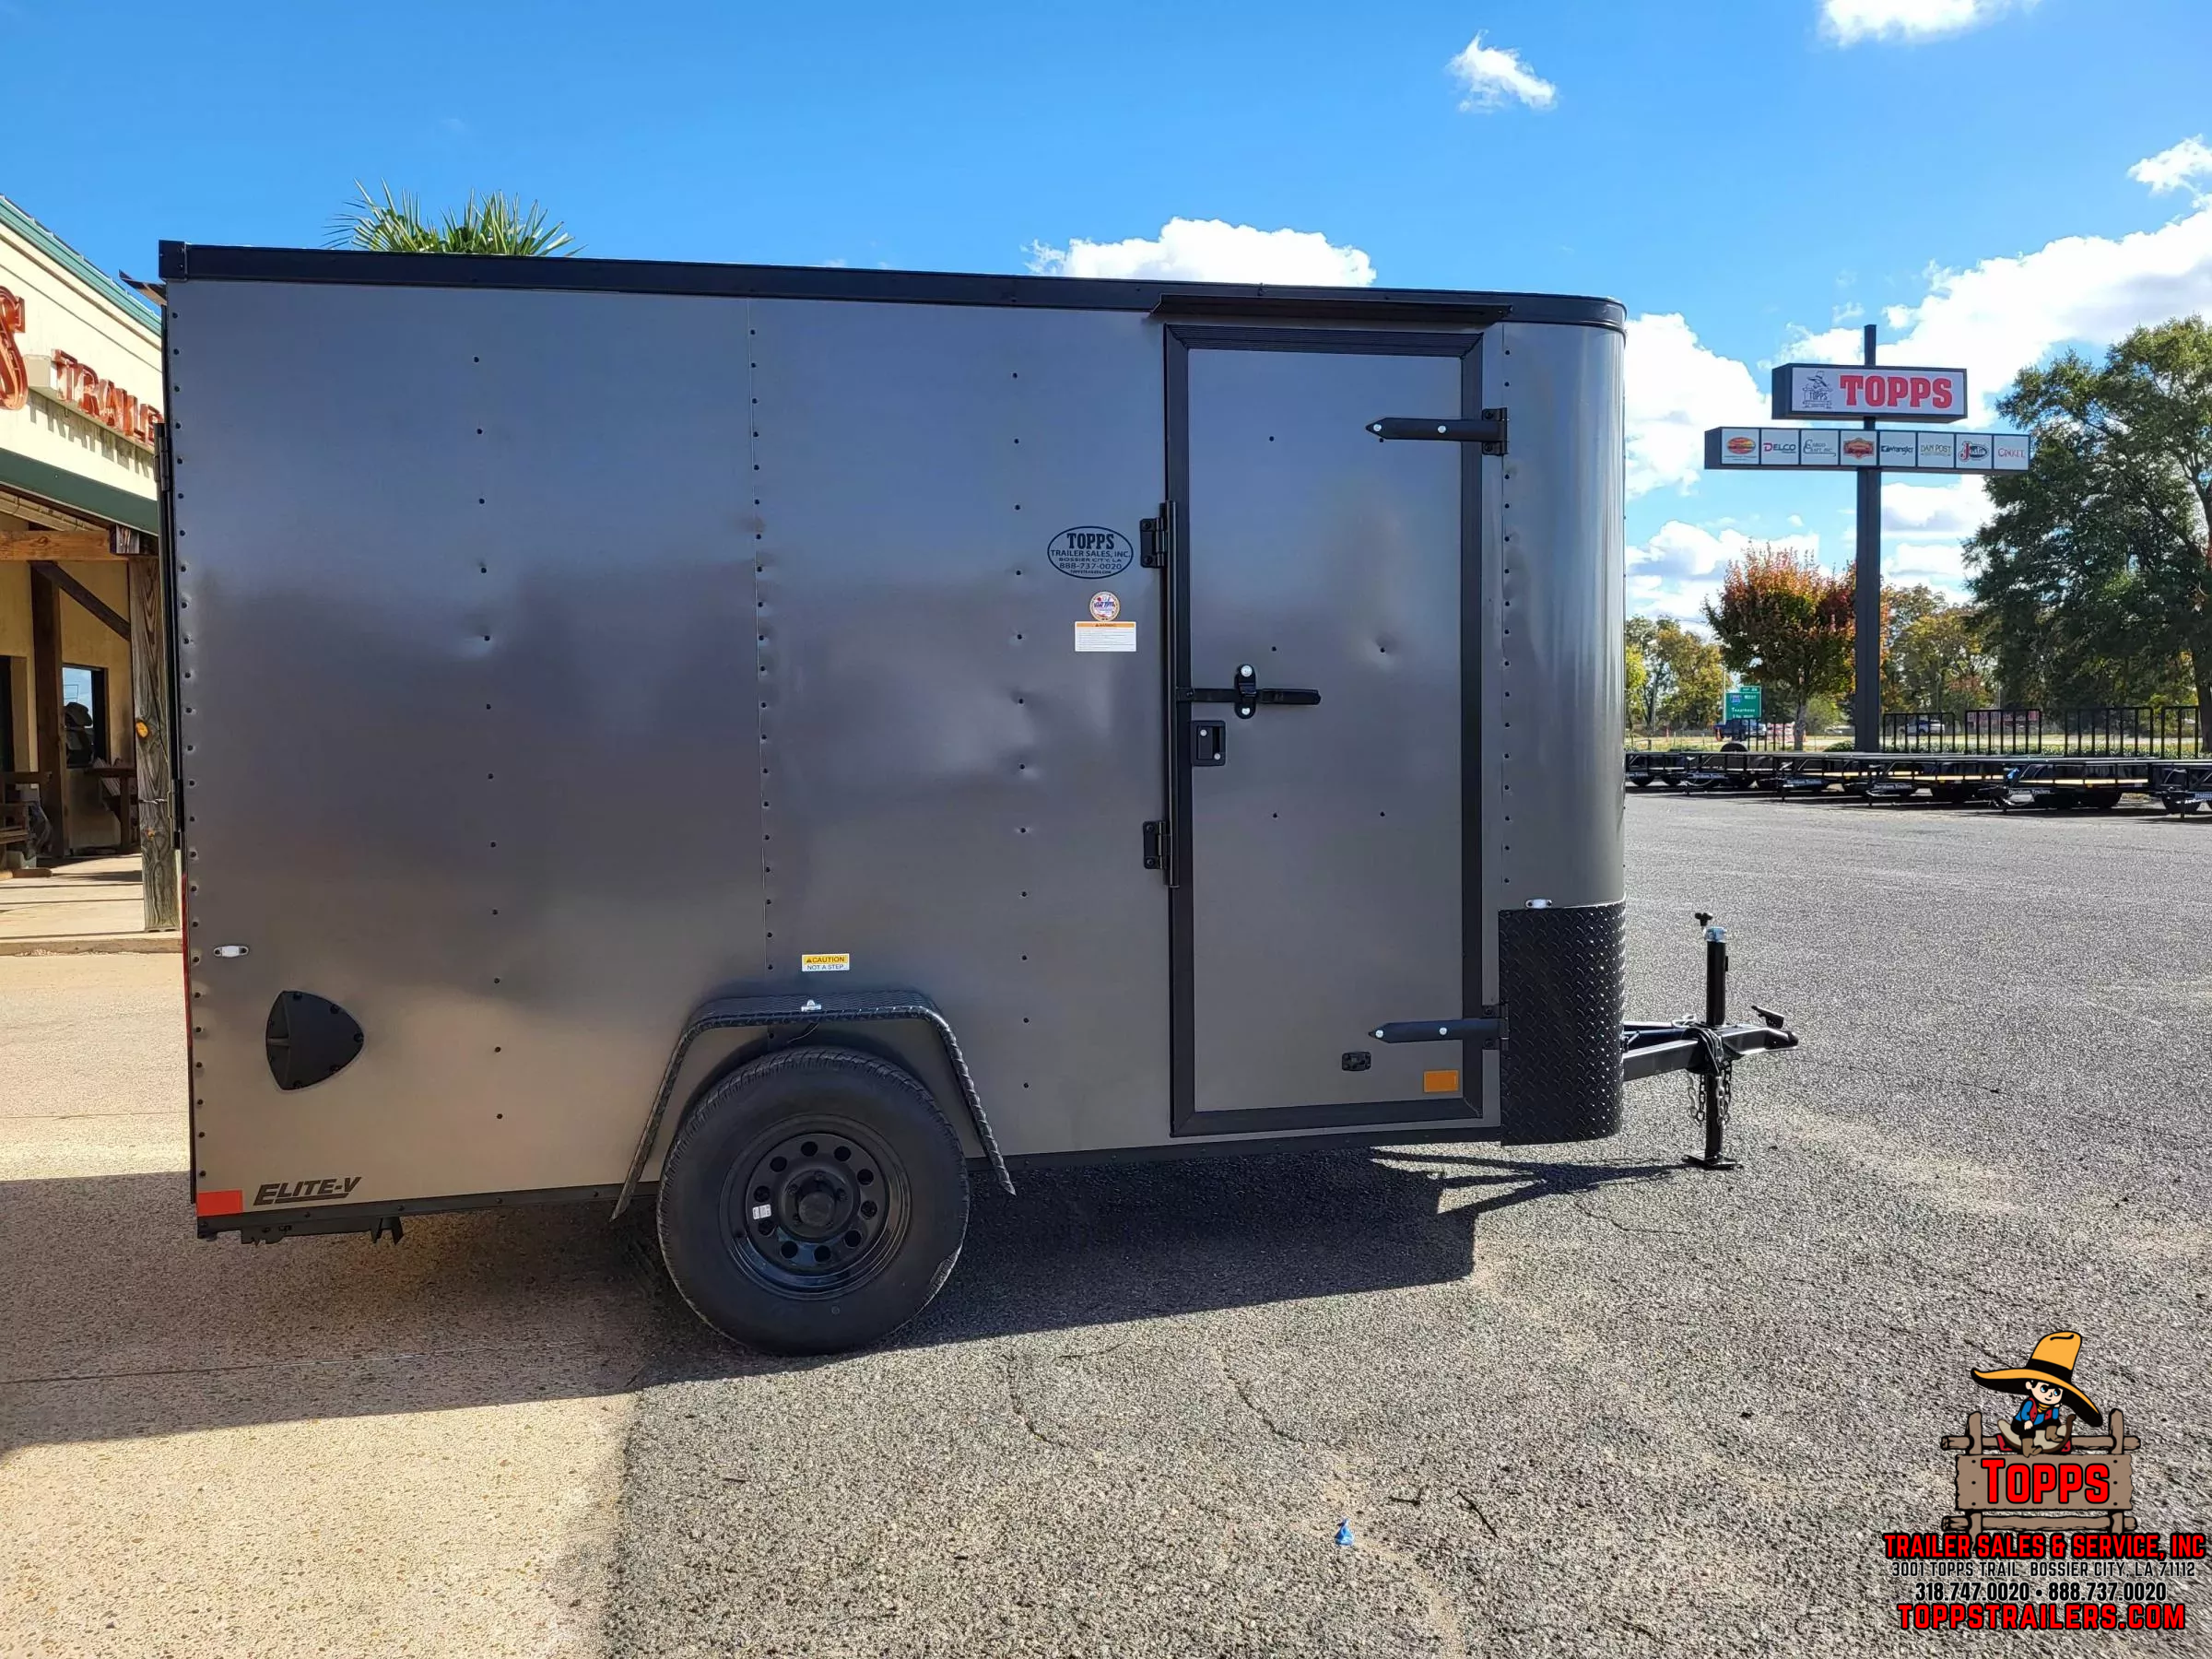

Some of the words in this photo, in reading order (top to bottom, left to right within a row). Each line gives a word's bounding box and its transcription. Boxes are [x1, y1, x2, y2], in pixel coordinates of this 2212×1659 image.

[1840, 374, 1953, 409] TOPPS
[1763, 442, 1796, 452] DELCO
[1066, 533, 1115, 550] TOPPS
[1086, 550, 1112, 559] SALES,
[1114, 550, 1131, 559] INC.
[1059, 562, 1123, 571] 888-737-0020
[253, 1176, 362, 1206] ELITE-V
